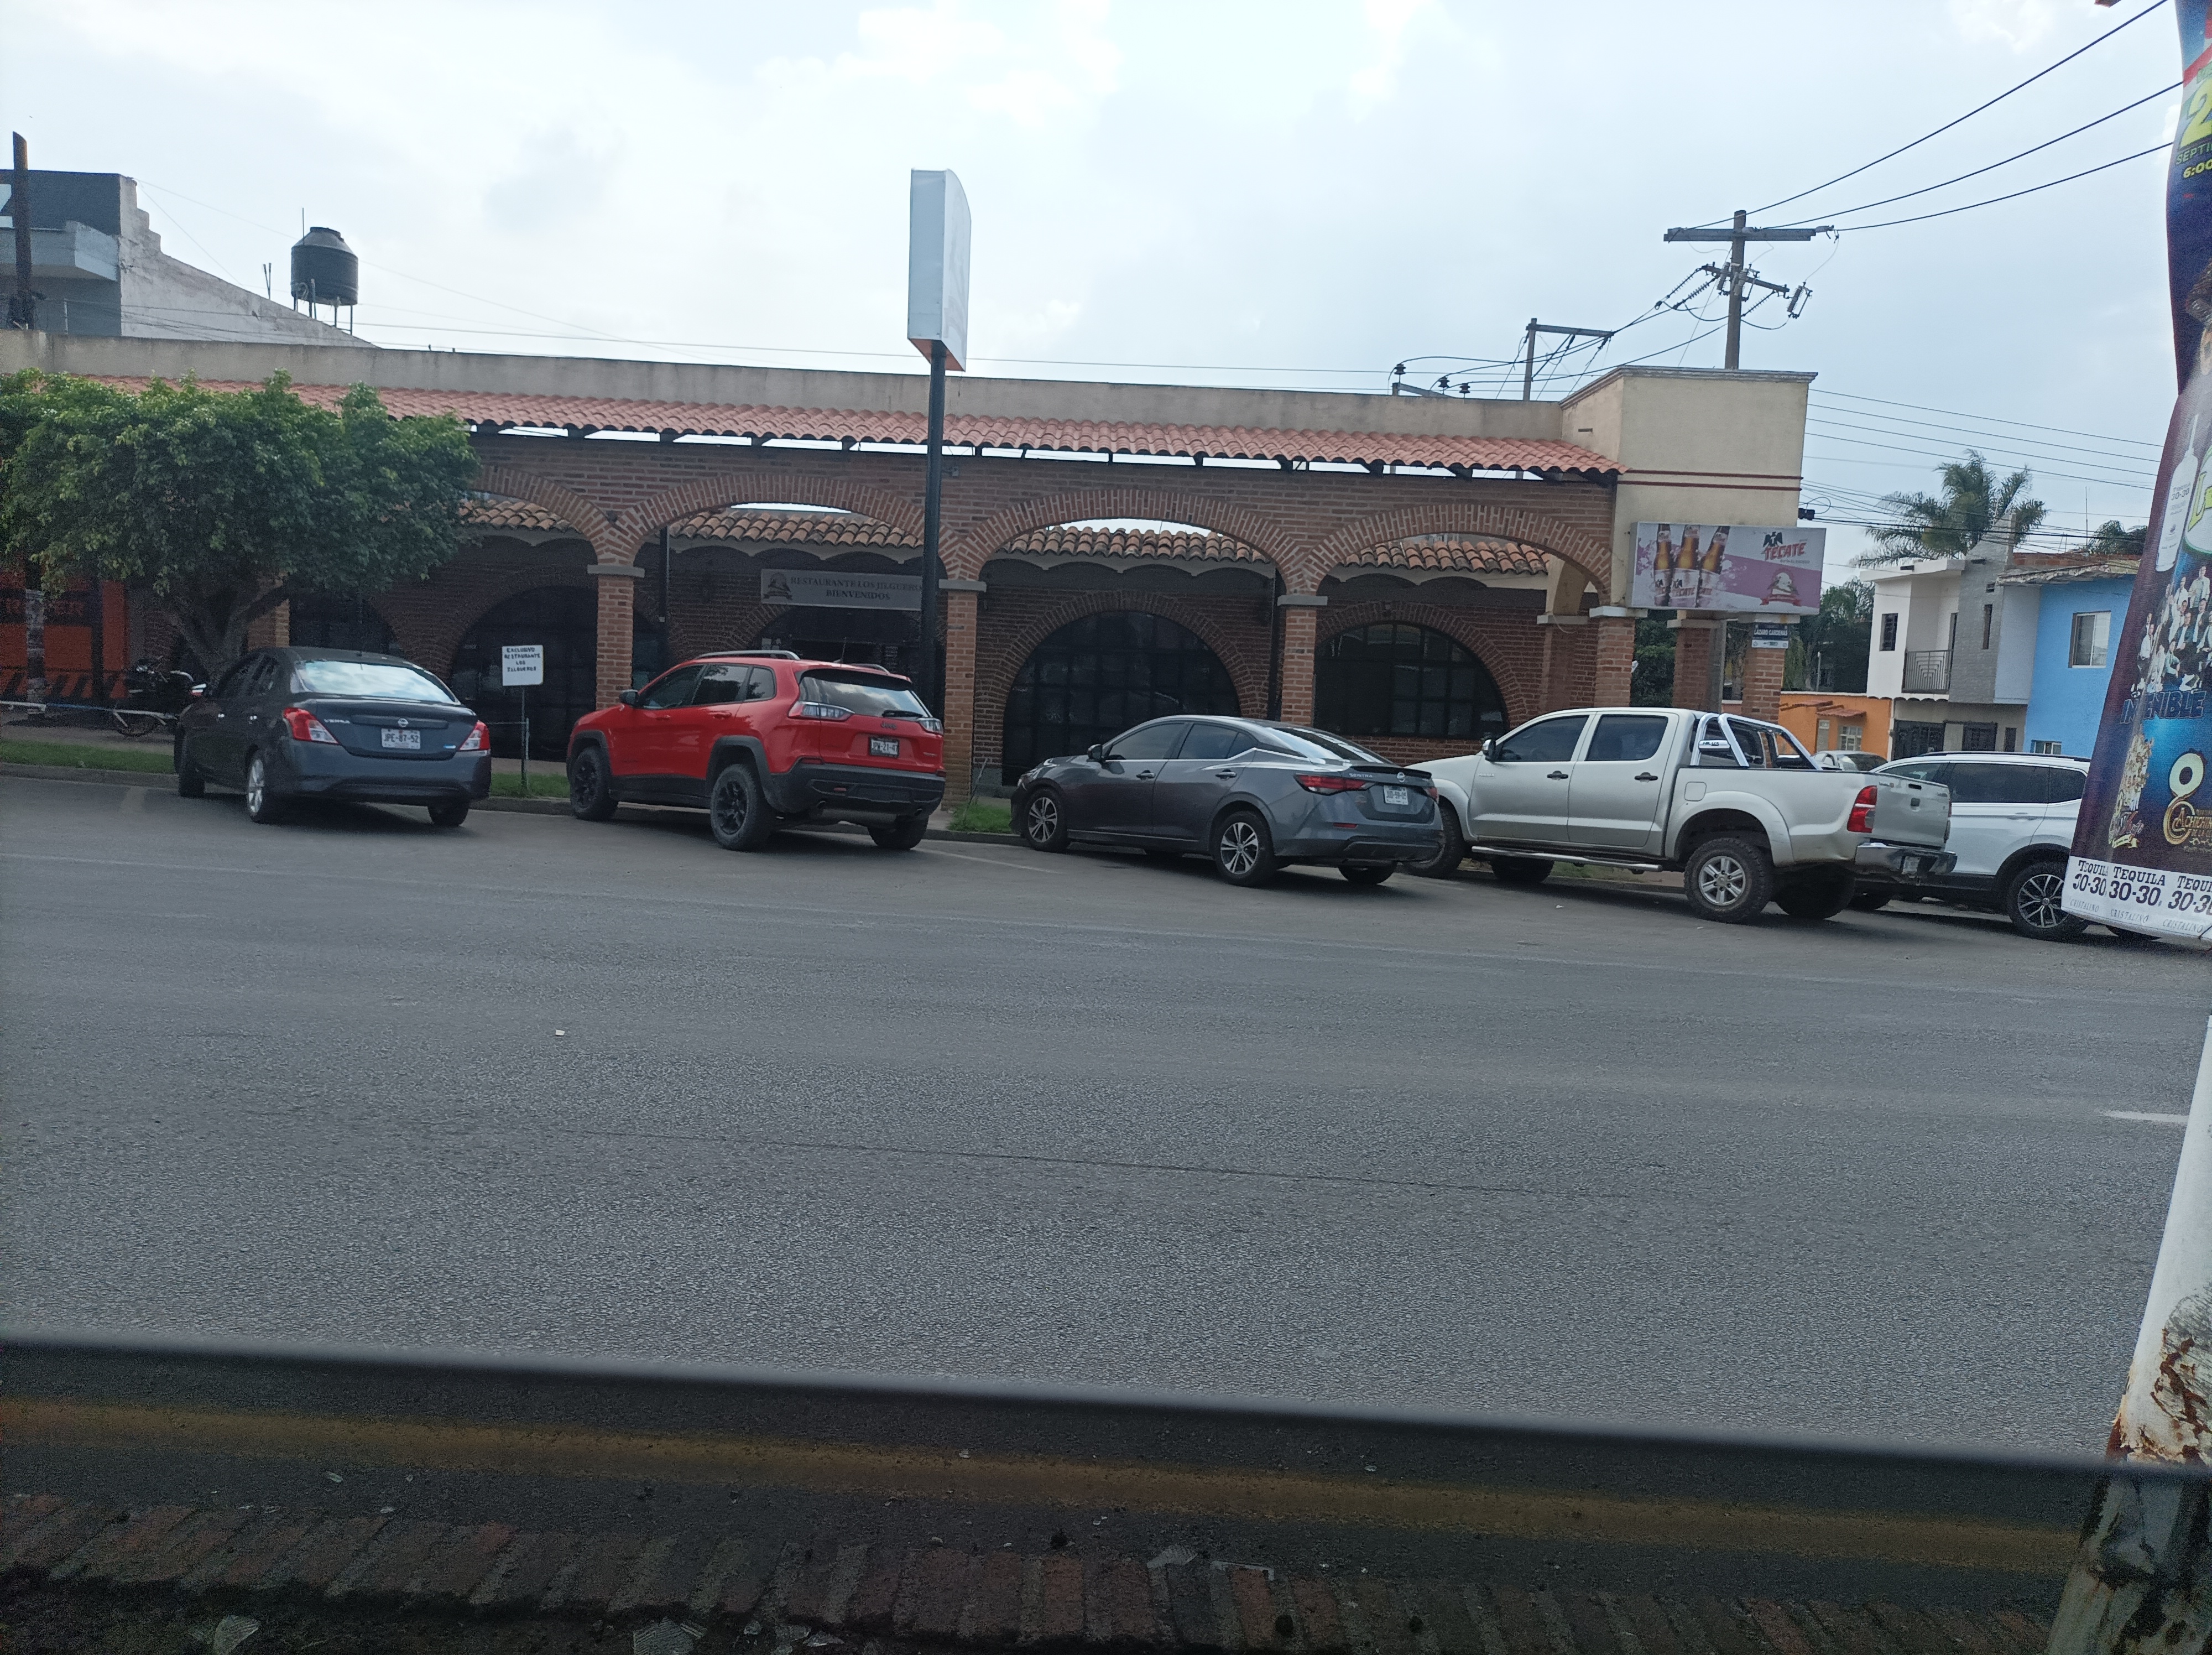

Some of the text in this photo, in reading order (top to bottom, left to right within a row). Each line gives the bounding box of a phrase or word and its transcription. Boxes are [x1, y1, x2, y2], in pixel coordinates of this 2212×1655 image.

[2176, 143, 2212, 165] SEPTI
[1762, 542, 1807, 561] TECATE
[790, 577, 922, 592] RESTAURANTE LOS JILGUERO
[826, 590, 890, 600] BIENVENIDOS
[880, 721, 897, 730] Jeep
[2114, 866, 2165, 886] TEQUILA
[2177, 876, 2212, 892] TEQUI
[2109, 880, 2161, 905] 30-30
[2110, 909, 2149, 923] CRISTALINO
[2163, 919, 2204, 933] CRISTALINO
